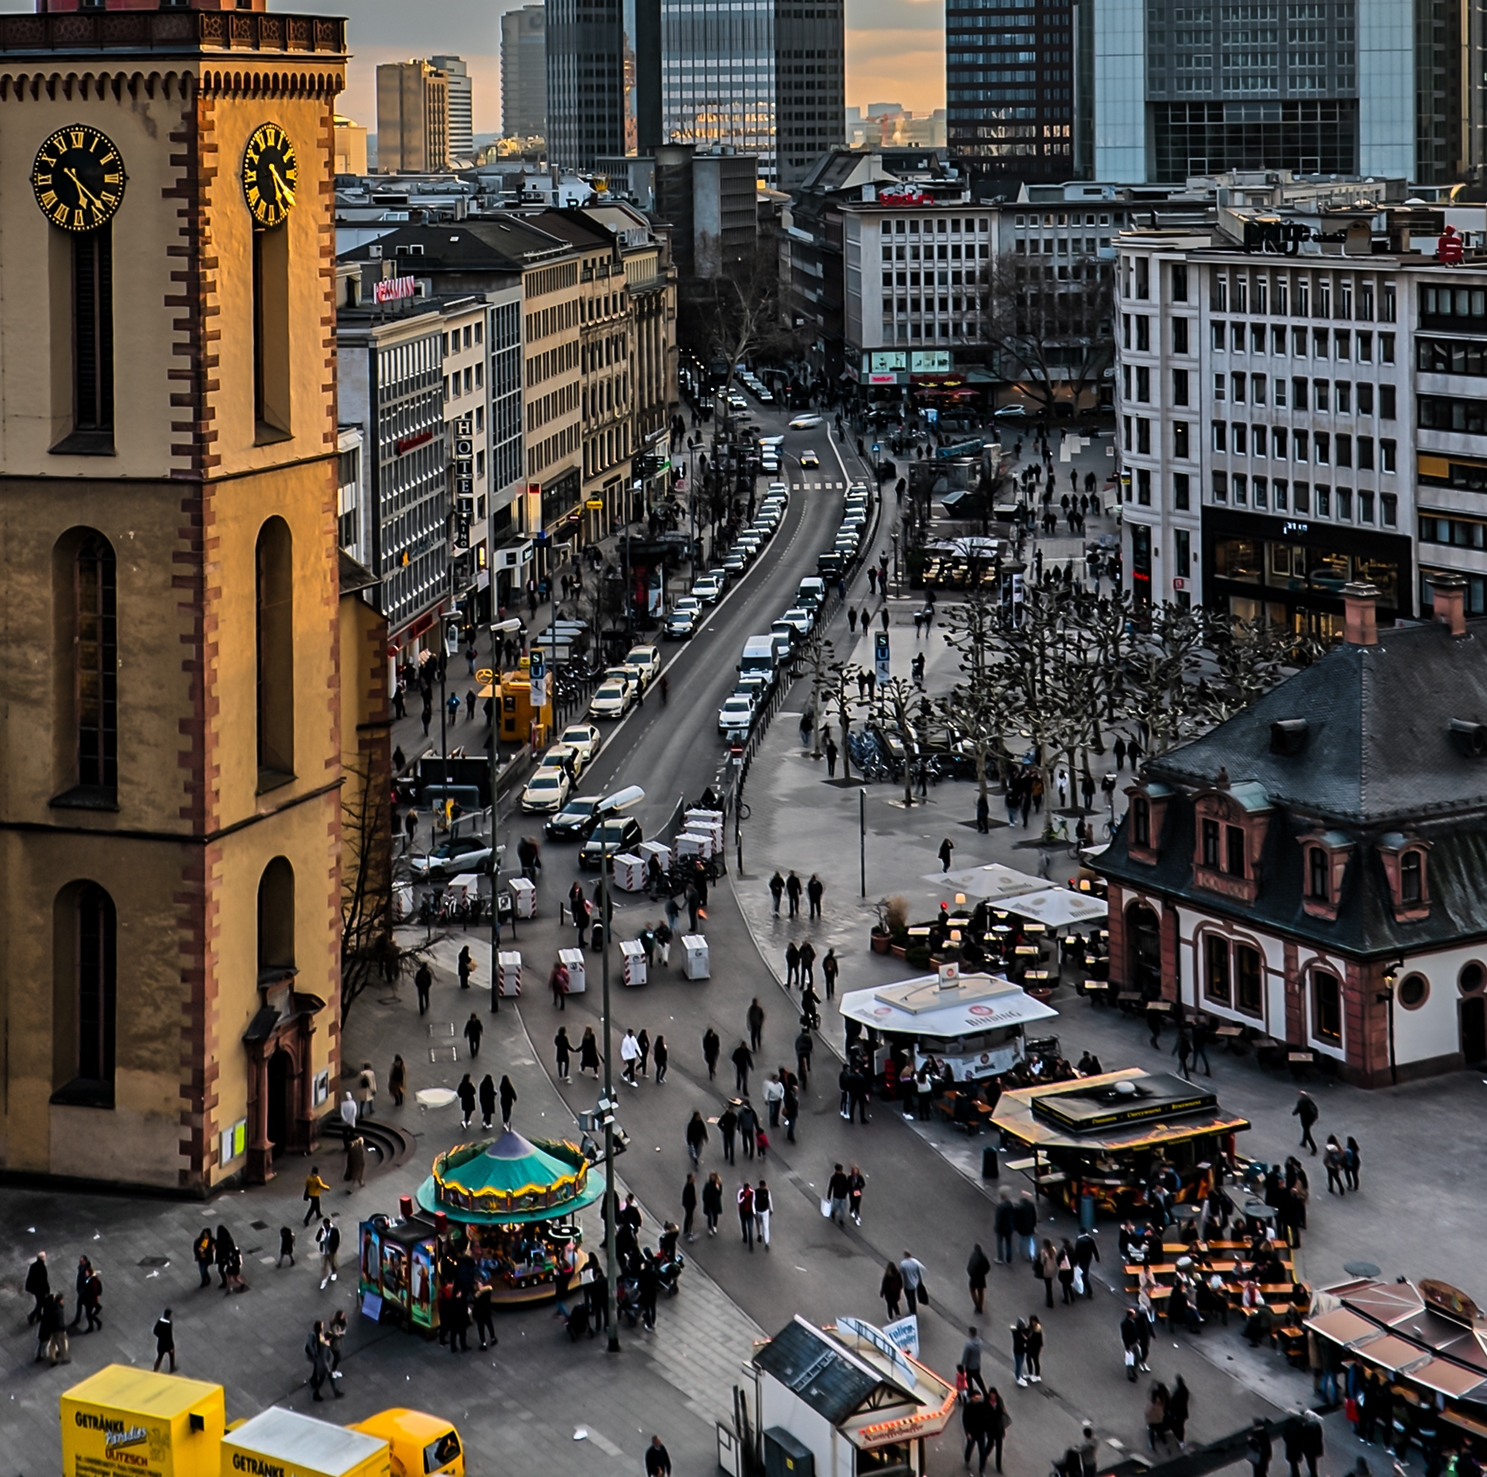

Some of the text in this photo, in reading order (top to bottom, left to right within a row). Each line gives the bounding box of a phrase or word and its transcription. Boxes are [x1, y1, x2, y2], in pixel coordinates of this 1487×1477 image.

[457, 421, 471, 512] HOTEL
[460, 519, 468, 548] KINO
[878, 636, 887, 646] S
[532, 653, 541, 663] S
[877, 648, 889, 660] U
[531, 665, 542, 678] U
[75, 1411, 125, 1432] GETRÄNKE
